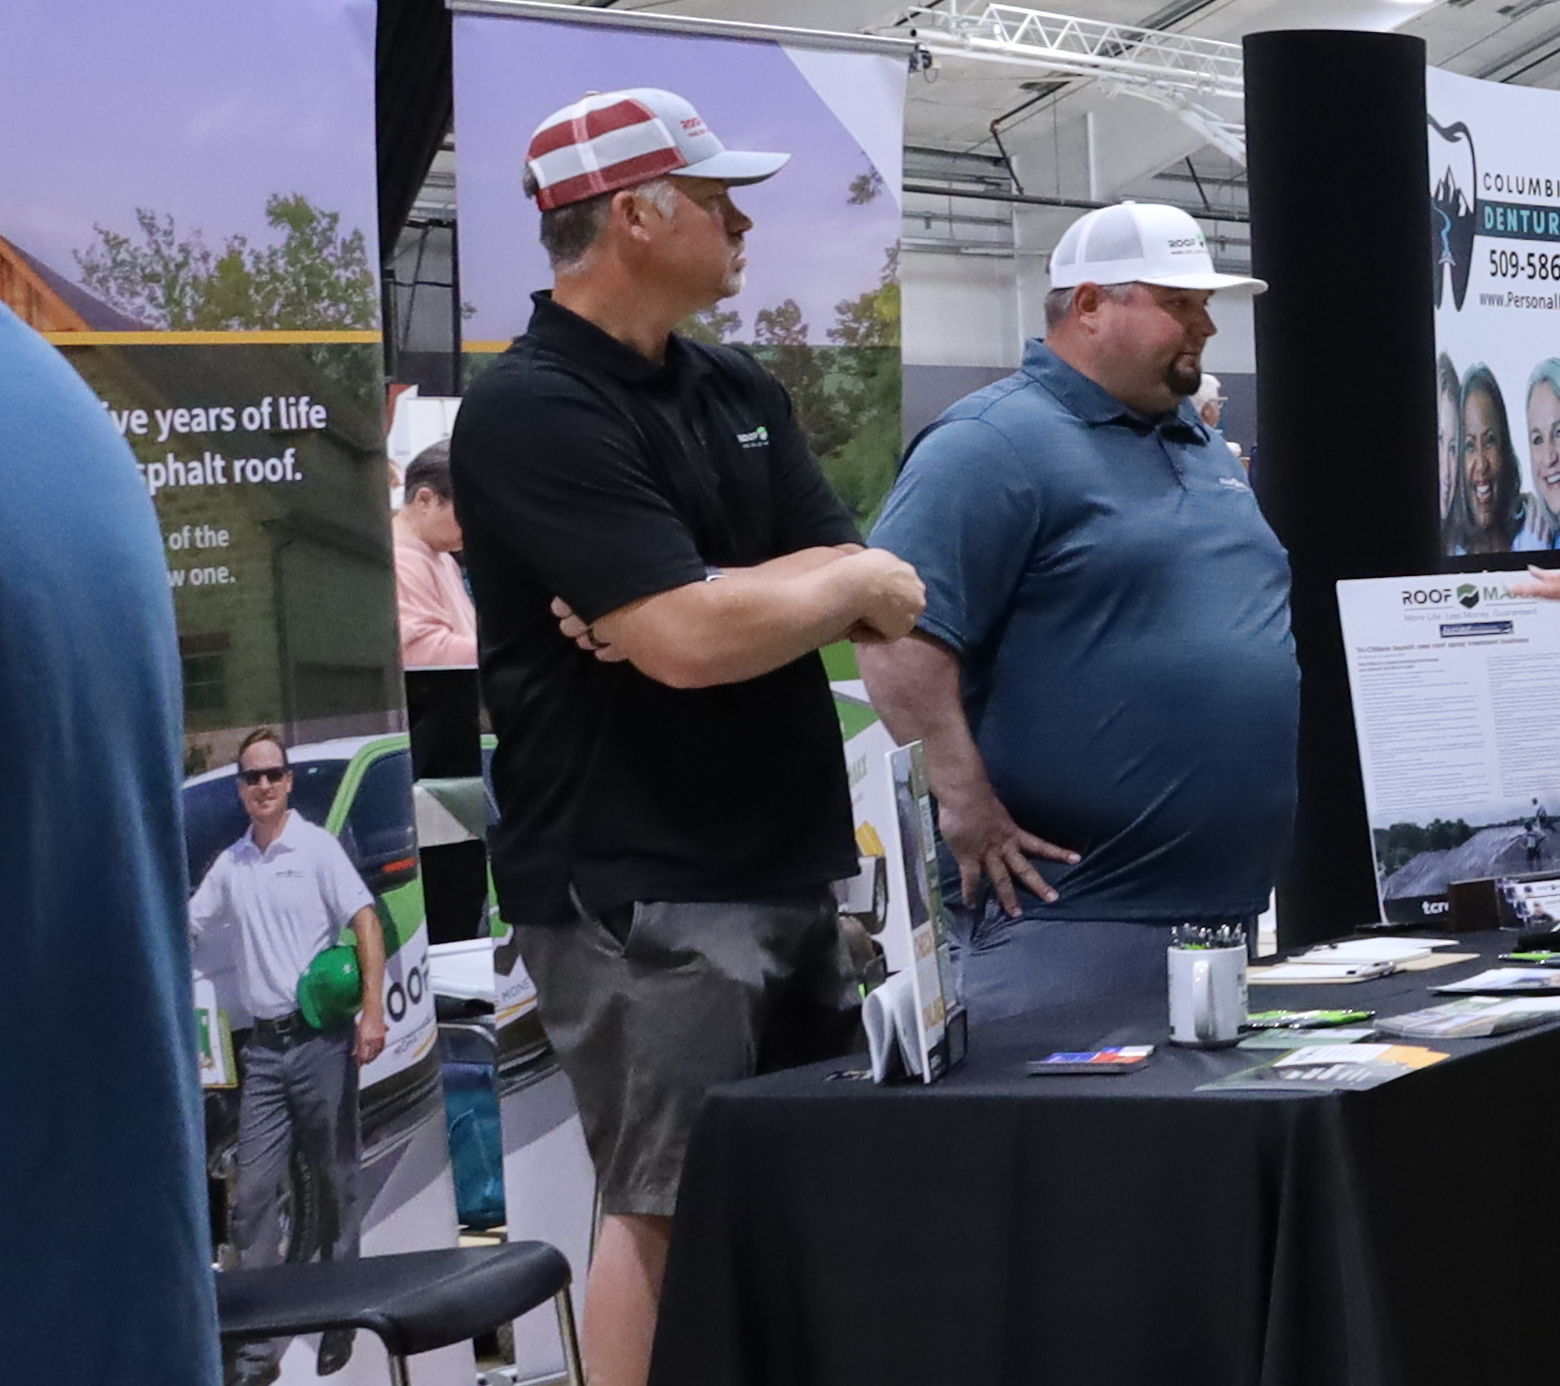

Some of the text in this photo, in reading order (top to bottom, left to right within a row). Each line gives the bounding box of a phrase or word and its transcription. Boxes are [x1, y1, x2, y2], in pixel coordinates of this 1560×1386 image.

[101, 395, 328, 442] ve years of life
[233, 447, 303, 483] roof.
[168, 524, 230, 551] of the
[189, 565, 237, 586] one.
[1402, 588, 1453, 606] ROOF
